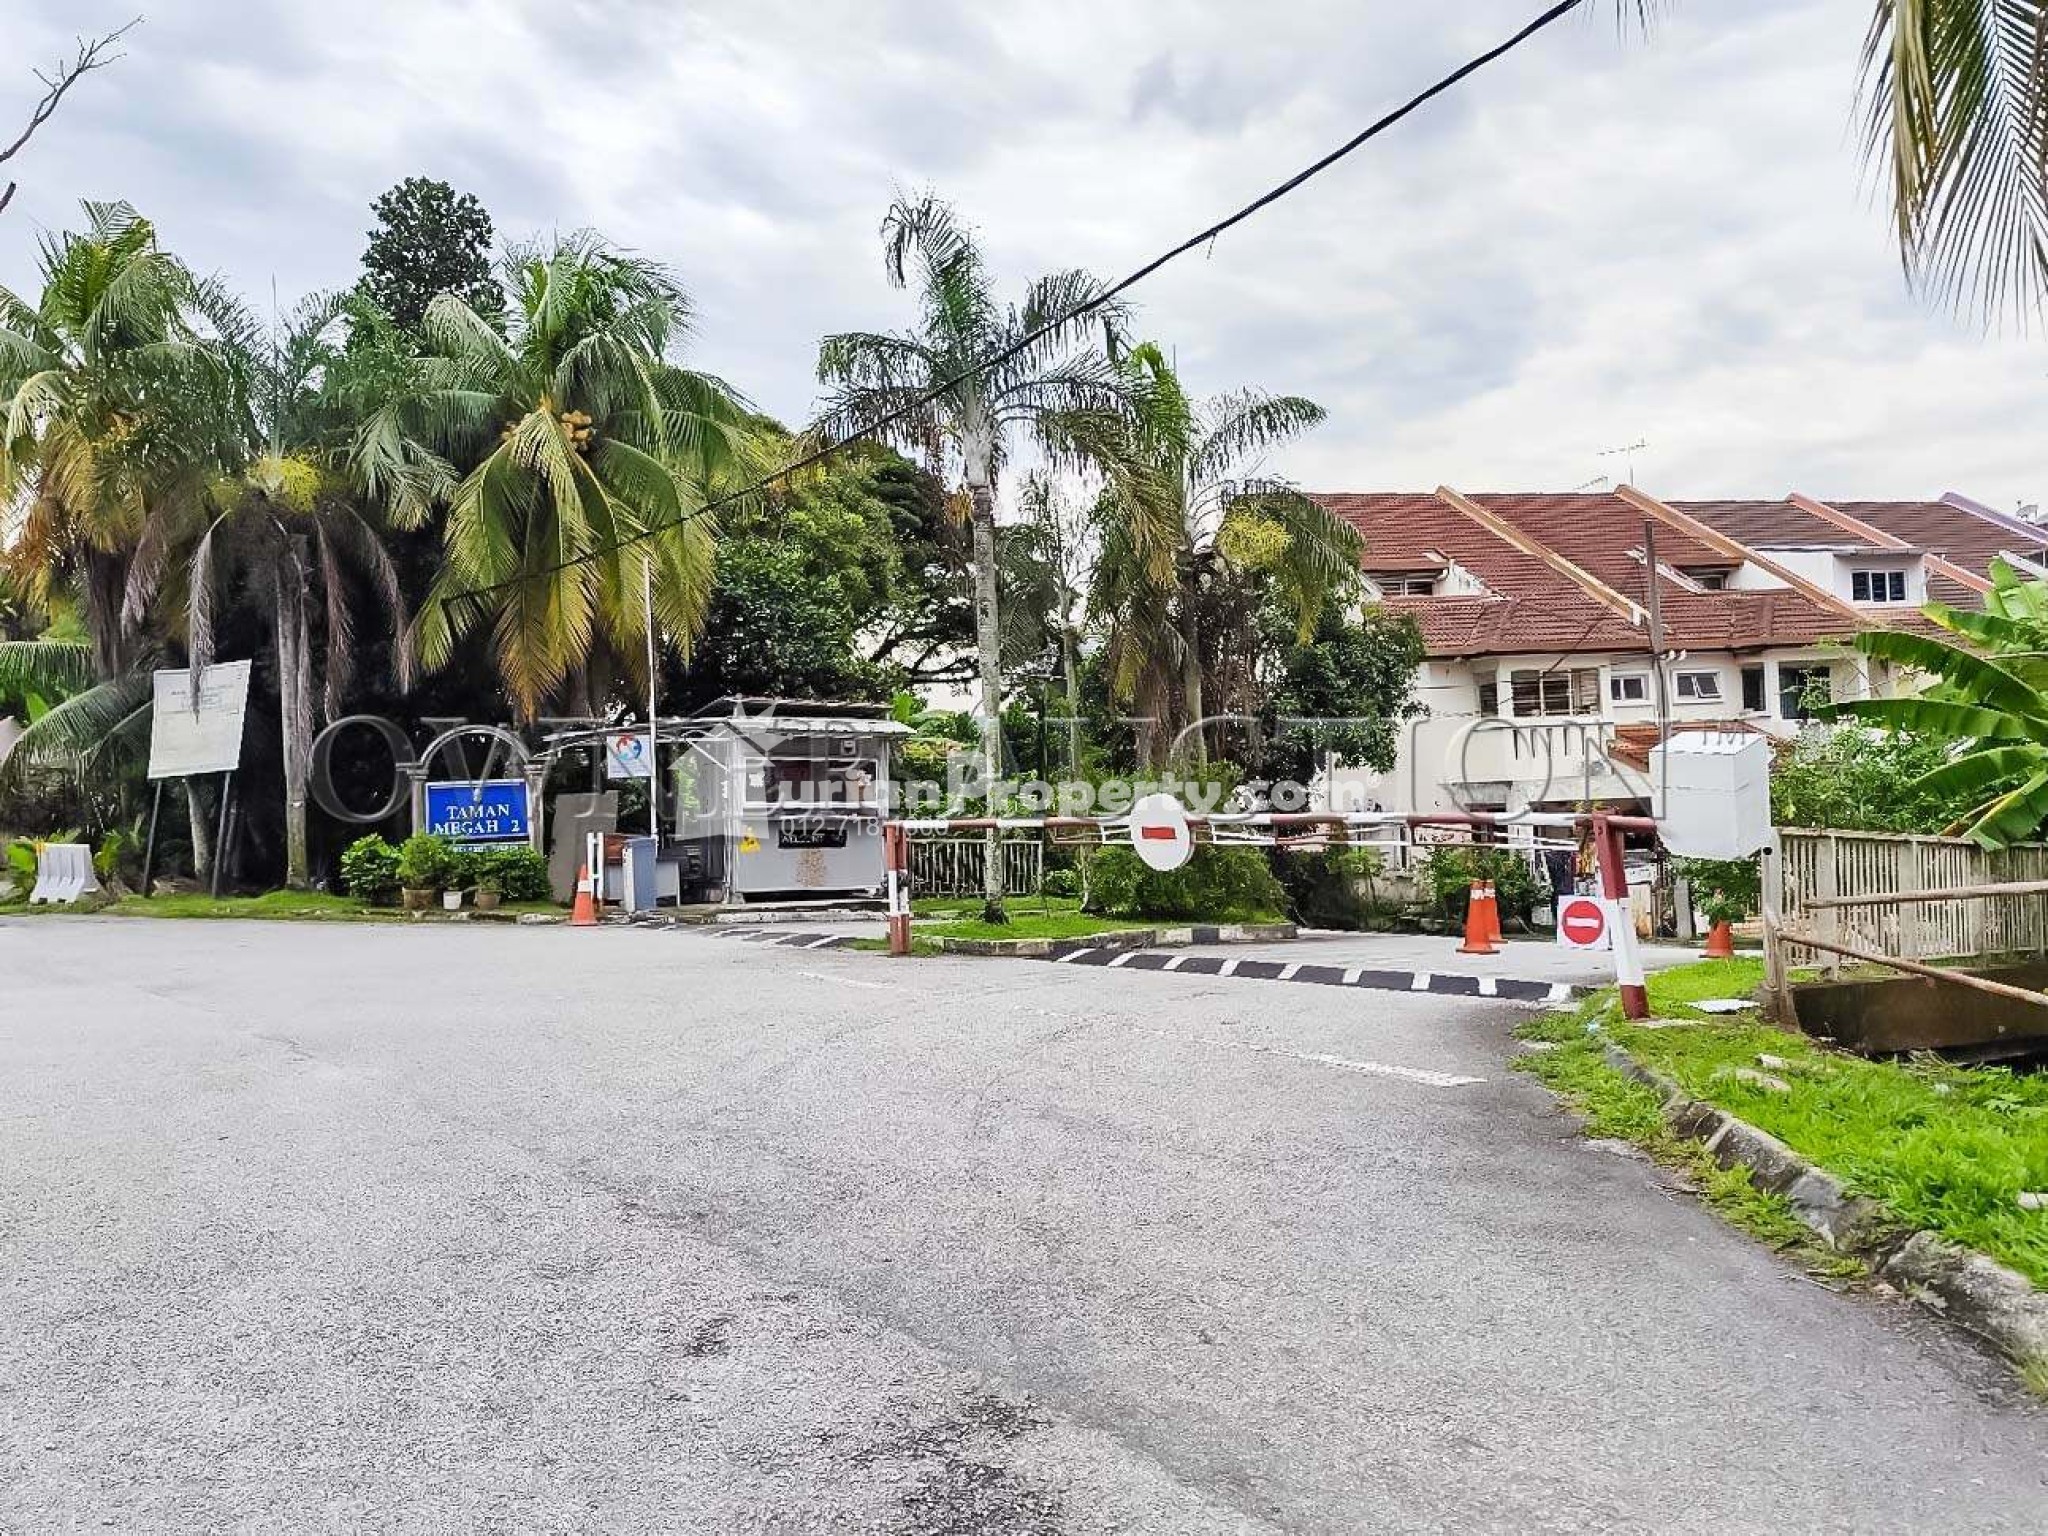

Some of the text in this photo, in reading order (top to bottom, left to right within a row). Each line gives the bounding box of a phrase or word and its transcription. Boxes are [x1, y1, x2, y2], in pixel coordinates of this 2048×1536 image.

[446, 804, 510, 819] TAMAN
[434, 820, 520, 835] MEGAH 2
